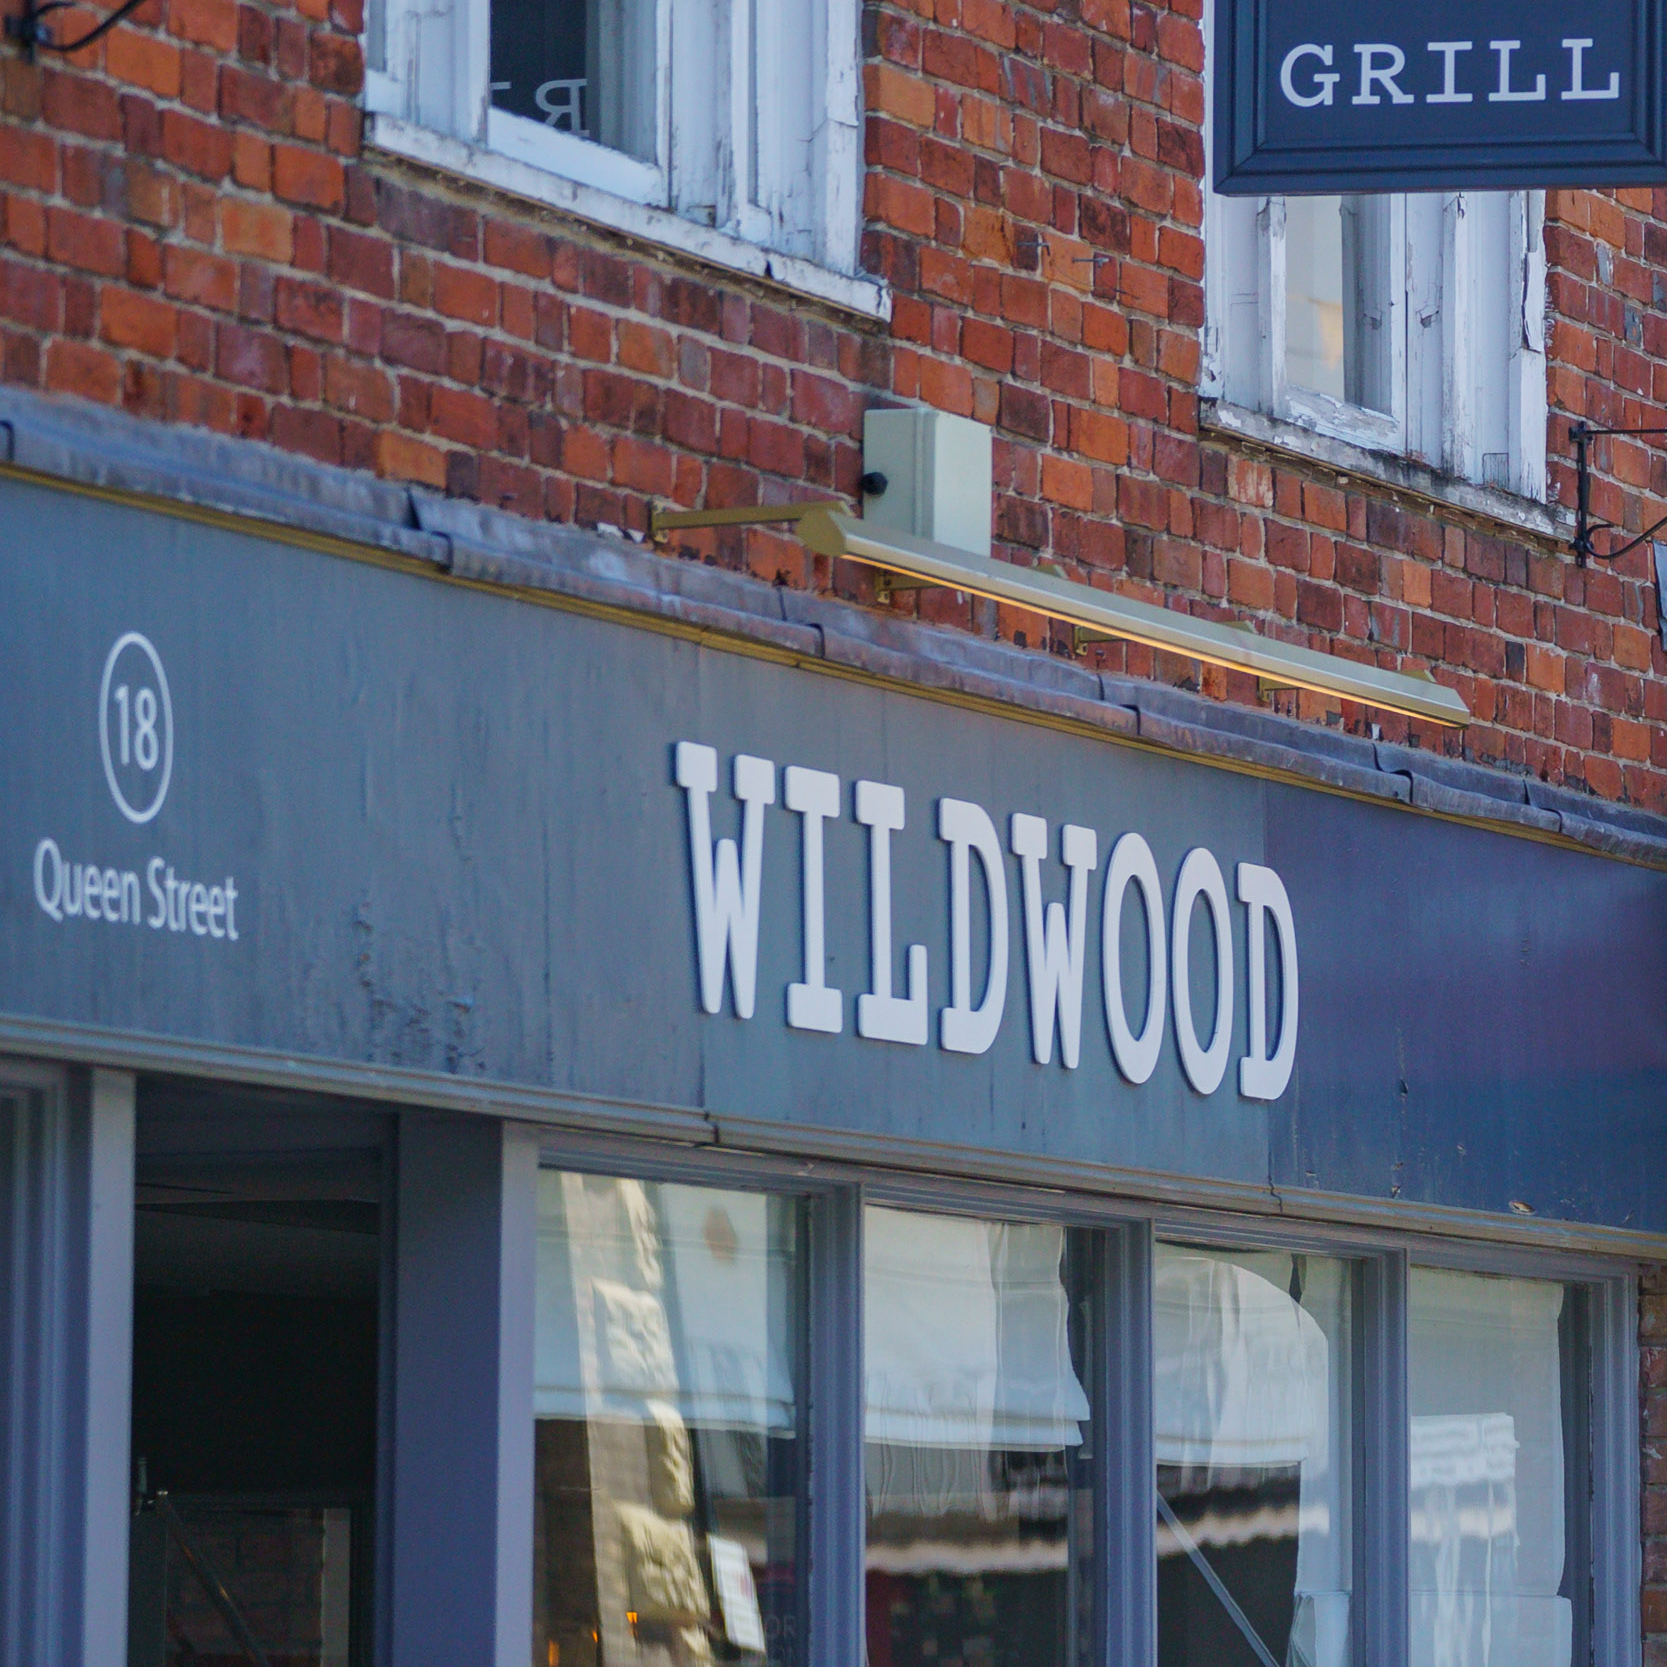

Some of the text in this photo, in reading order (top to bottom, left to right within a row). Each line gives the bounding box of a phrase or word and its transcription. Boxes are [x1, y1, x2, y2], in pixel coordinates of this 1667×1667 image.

[1280, 37, 1620, 108] GRILL
[114, 683, 162, 771] 18
[33, 836, 241, 942] Queen Street
[673, 740, 1301, 1102] WILDWOOD
